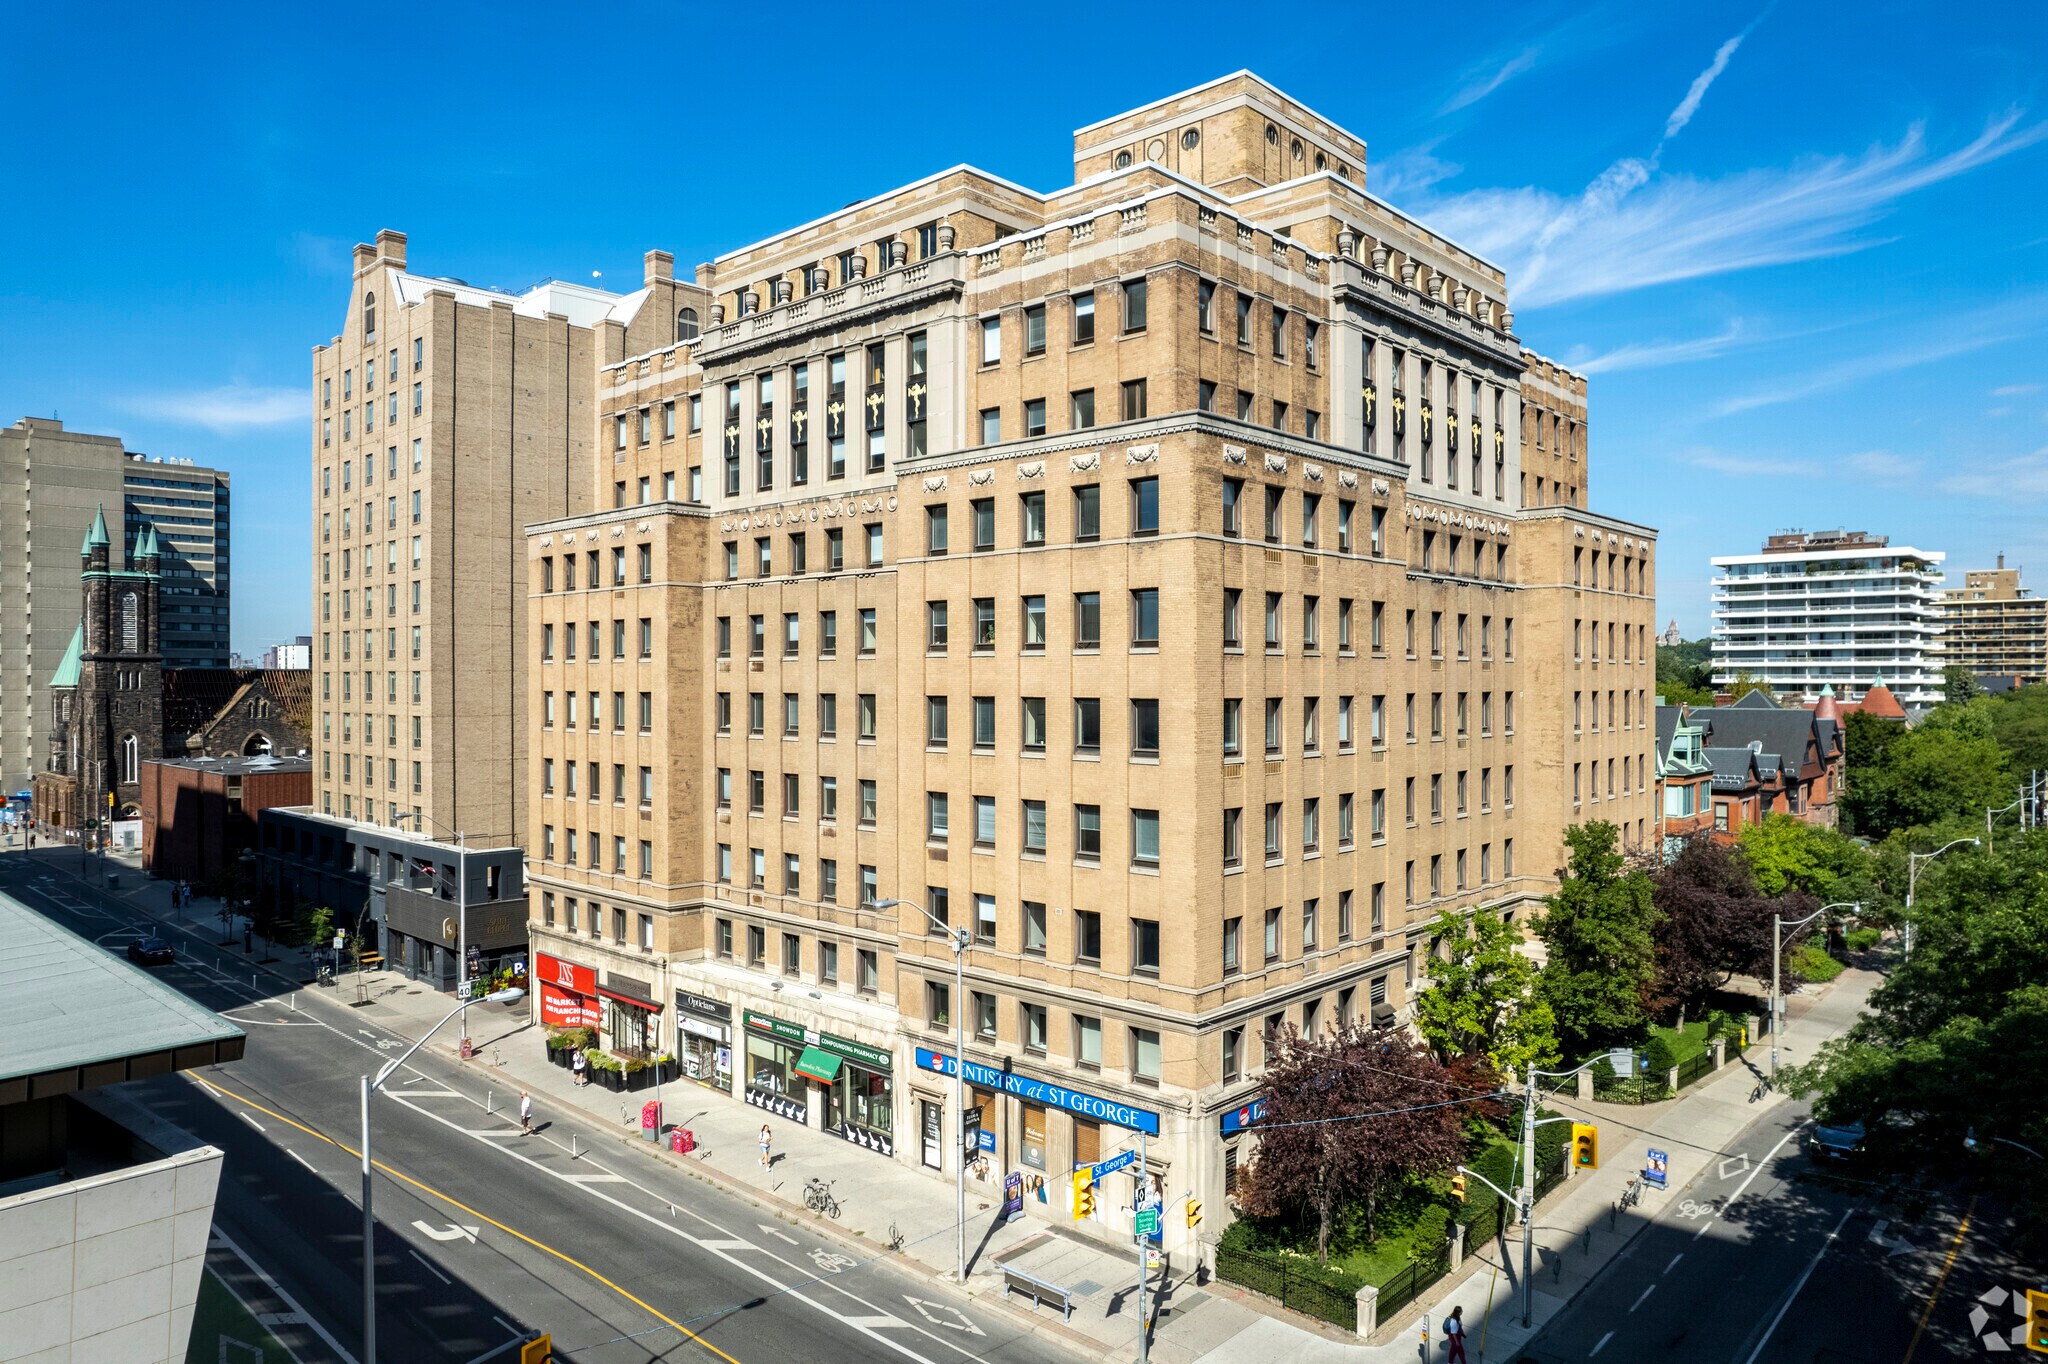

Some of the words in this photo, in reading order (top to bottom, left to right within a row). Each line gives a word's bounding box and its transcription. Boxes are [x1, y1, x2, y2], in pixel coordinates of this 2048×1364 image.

[514, 962, 523, 974] P
[459, 987, 470, 996] 40
[688, 995, 715, 1011] Opticians
[776, 1024, 800, 1036] SNOWDON
[821, 1037, 853, 1053] COMPOUNDING
[853, 1048, 878, 1060] PHARMACY
[1027, 1083, 1044, 1099] at
[1049, 1088, 1067, 1106] ST
[1071, 1094, 1139, 1128] GEORGE
[1105, 1155, 1127, 1172] George
